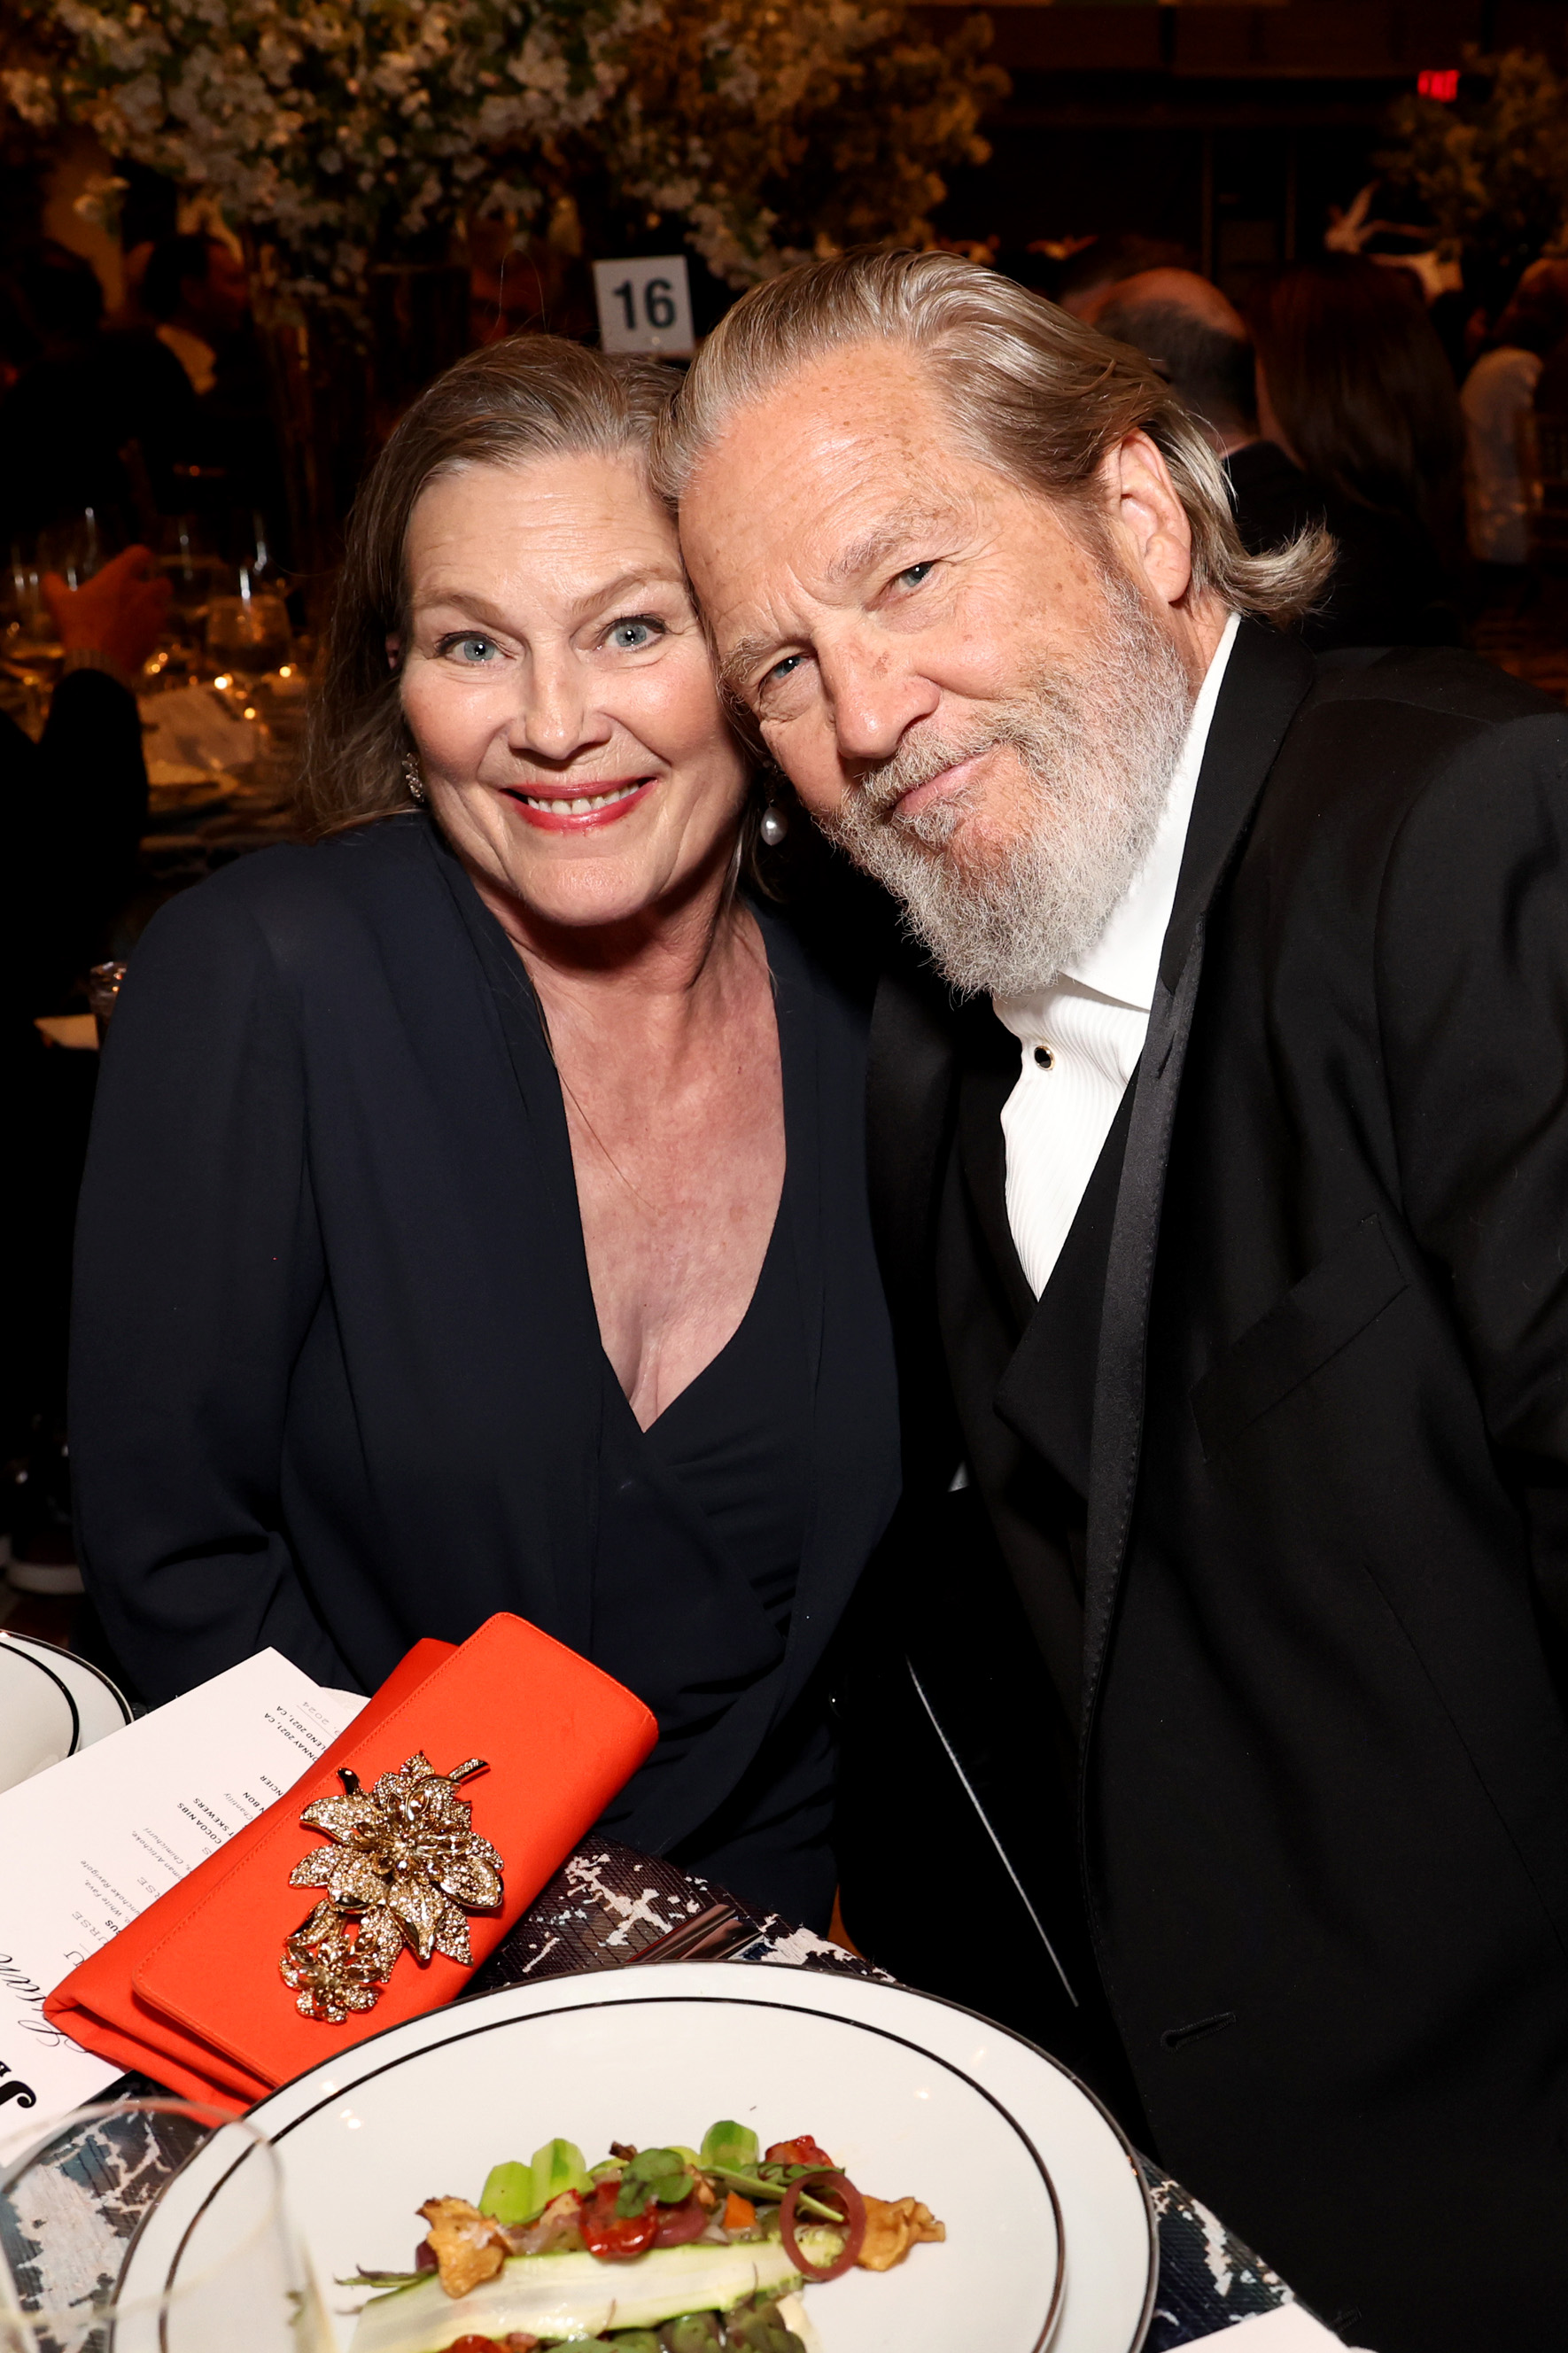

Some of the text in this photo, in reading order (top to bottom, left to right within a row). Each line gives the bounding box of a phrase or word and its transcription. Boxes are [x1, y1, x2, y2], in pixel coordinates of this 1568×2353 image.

[614, 278, 676, 330] 16
[264, 1712, 276, 1723] CA
[276, 1705, 288, 1716] CA
[302, 1701, 329, 1726] 2024
[276, 1721, 296, 1741] 2021,
[288, 1714, 307, 1734] 2021,
[259, 1774, 283, 1797] NCIER
[223, 1793, 254, 1821] Chantilly
[242, 1791, 261, 1808] BON
[176, 1802, 223, 1844] COCOA NIBS
[192, 1798, 230, 1832] SKEWERS
[130, 1829, 166, 1863] Artichoke,
[142, 1827, 184, 1865] Chimichurri
[80, 1859, 112, 1889] Ravigote
[84, 1879, 103, 1898] Fava,
[101, 1897, 123, 1917] White
